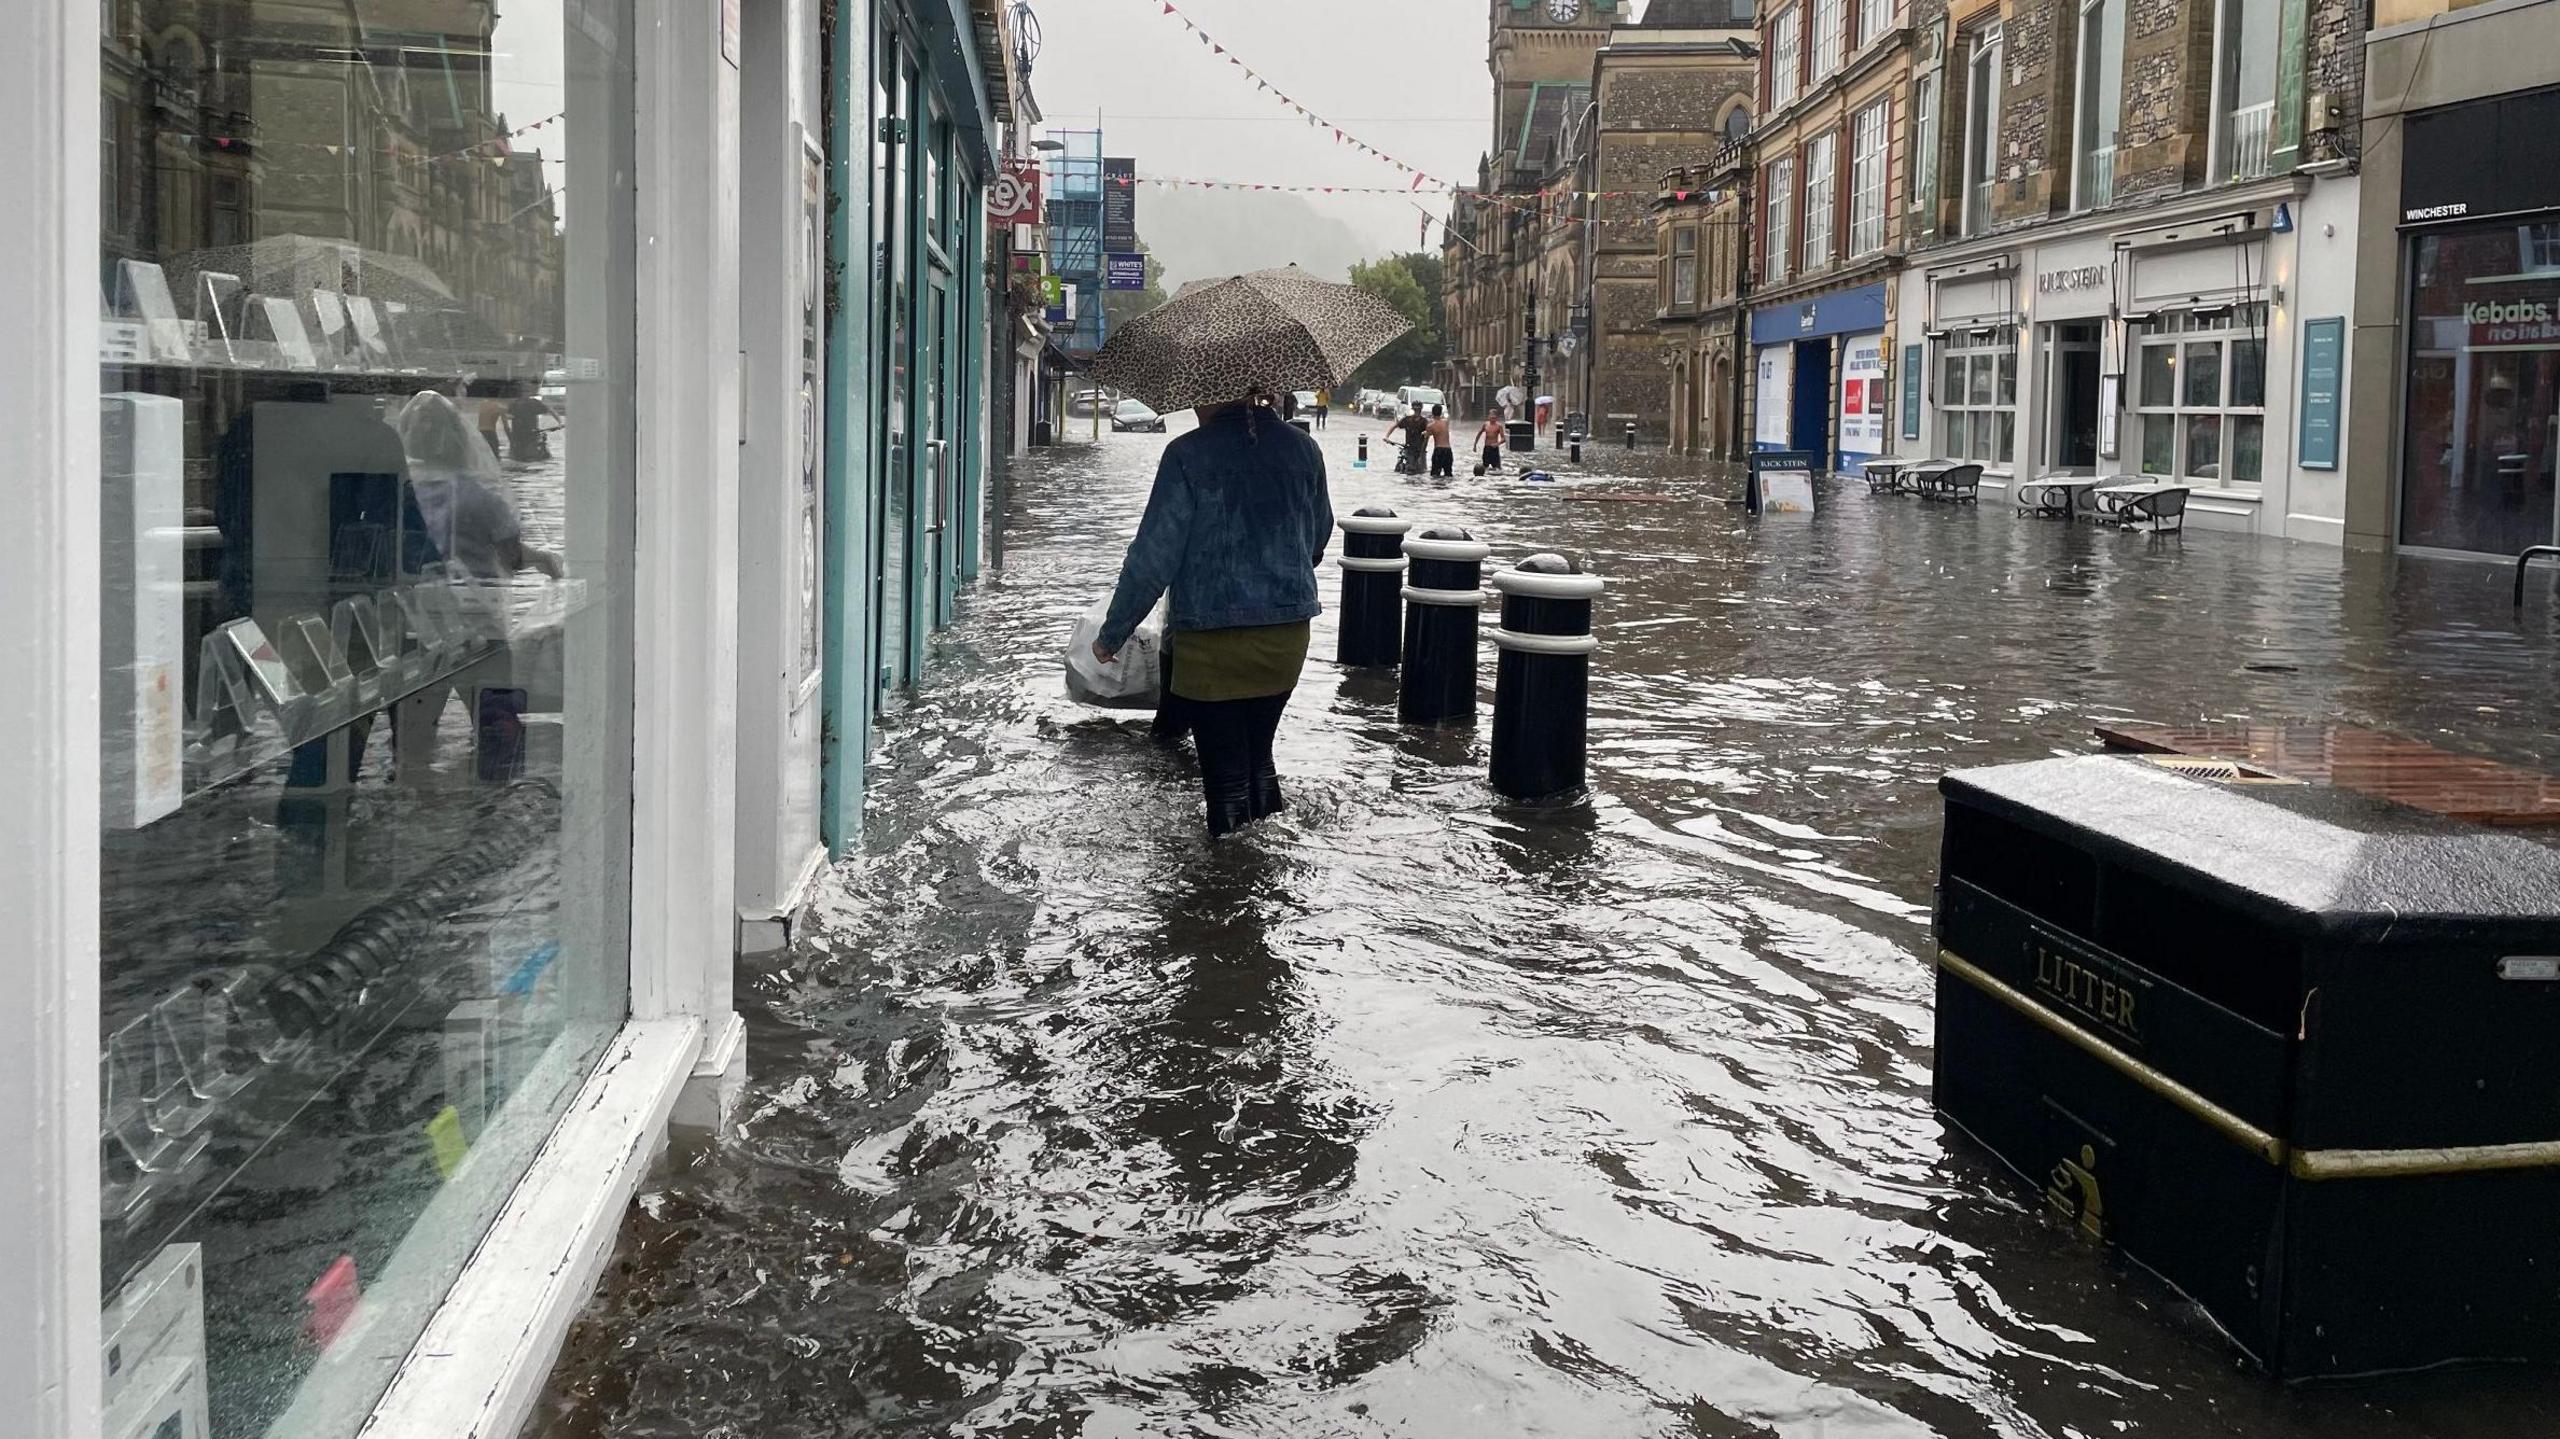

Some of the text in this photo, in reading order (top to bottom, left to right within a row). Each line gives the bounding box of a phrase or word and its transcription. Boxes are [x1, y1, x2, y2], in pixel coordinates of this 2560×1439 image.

[2406, 203, 2467, 220] WINCHESTER
[2039, 264, 2105, 293] RICK STEIN
[1760, 459, 1807, 468] RICK STEIN
[2034, 947, 2138, 1032] LITTER
